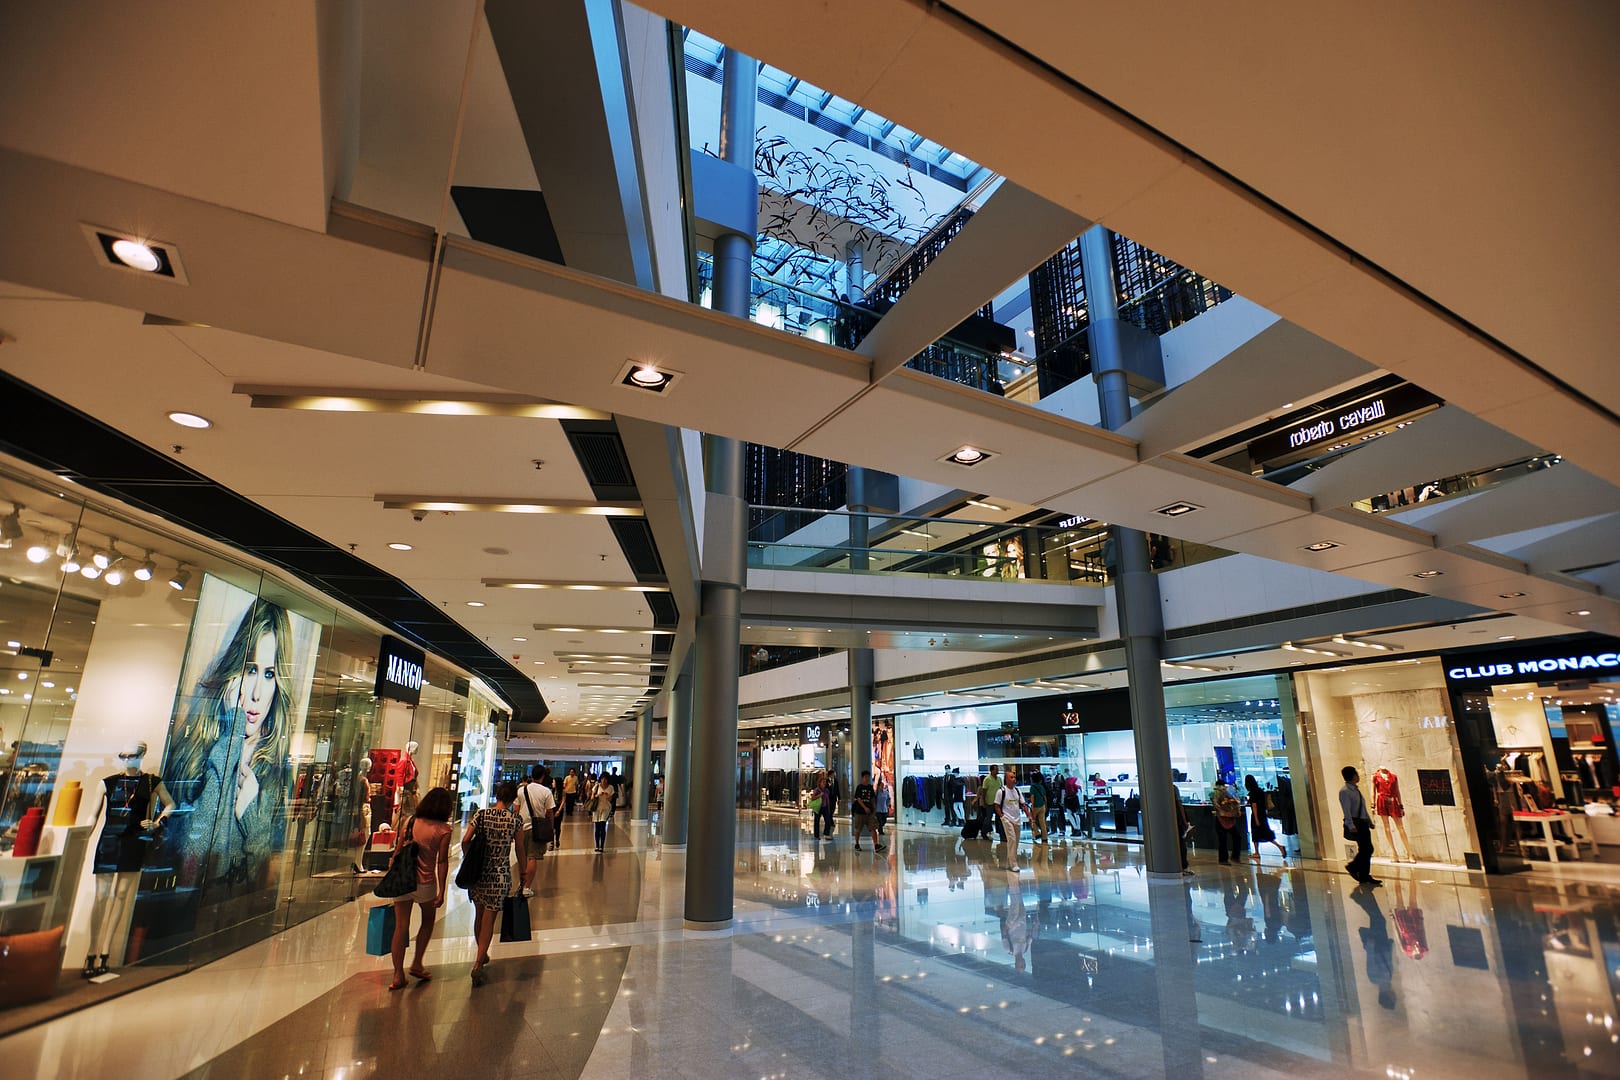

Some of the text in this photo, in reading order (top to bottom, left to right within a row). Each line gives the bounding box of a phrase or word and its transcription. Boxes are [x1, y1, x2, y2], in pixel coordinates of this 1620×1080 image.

[1289, 399, 1386, 448] roberto cavalli
[386, 654, 422, 690] MANGO
[1449, 653, 1620, 679] CLUB MONAC
[807, 726, 820, 738] D&G
